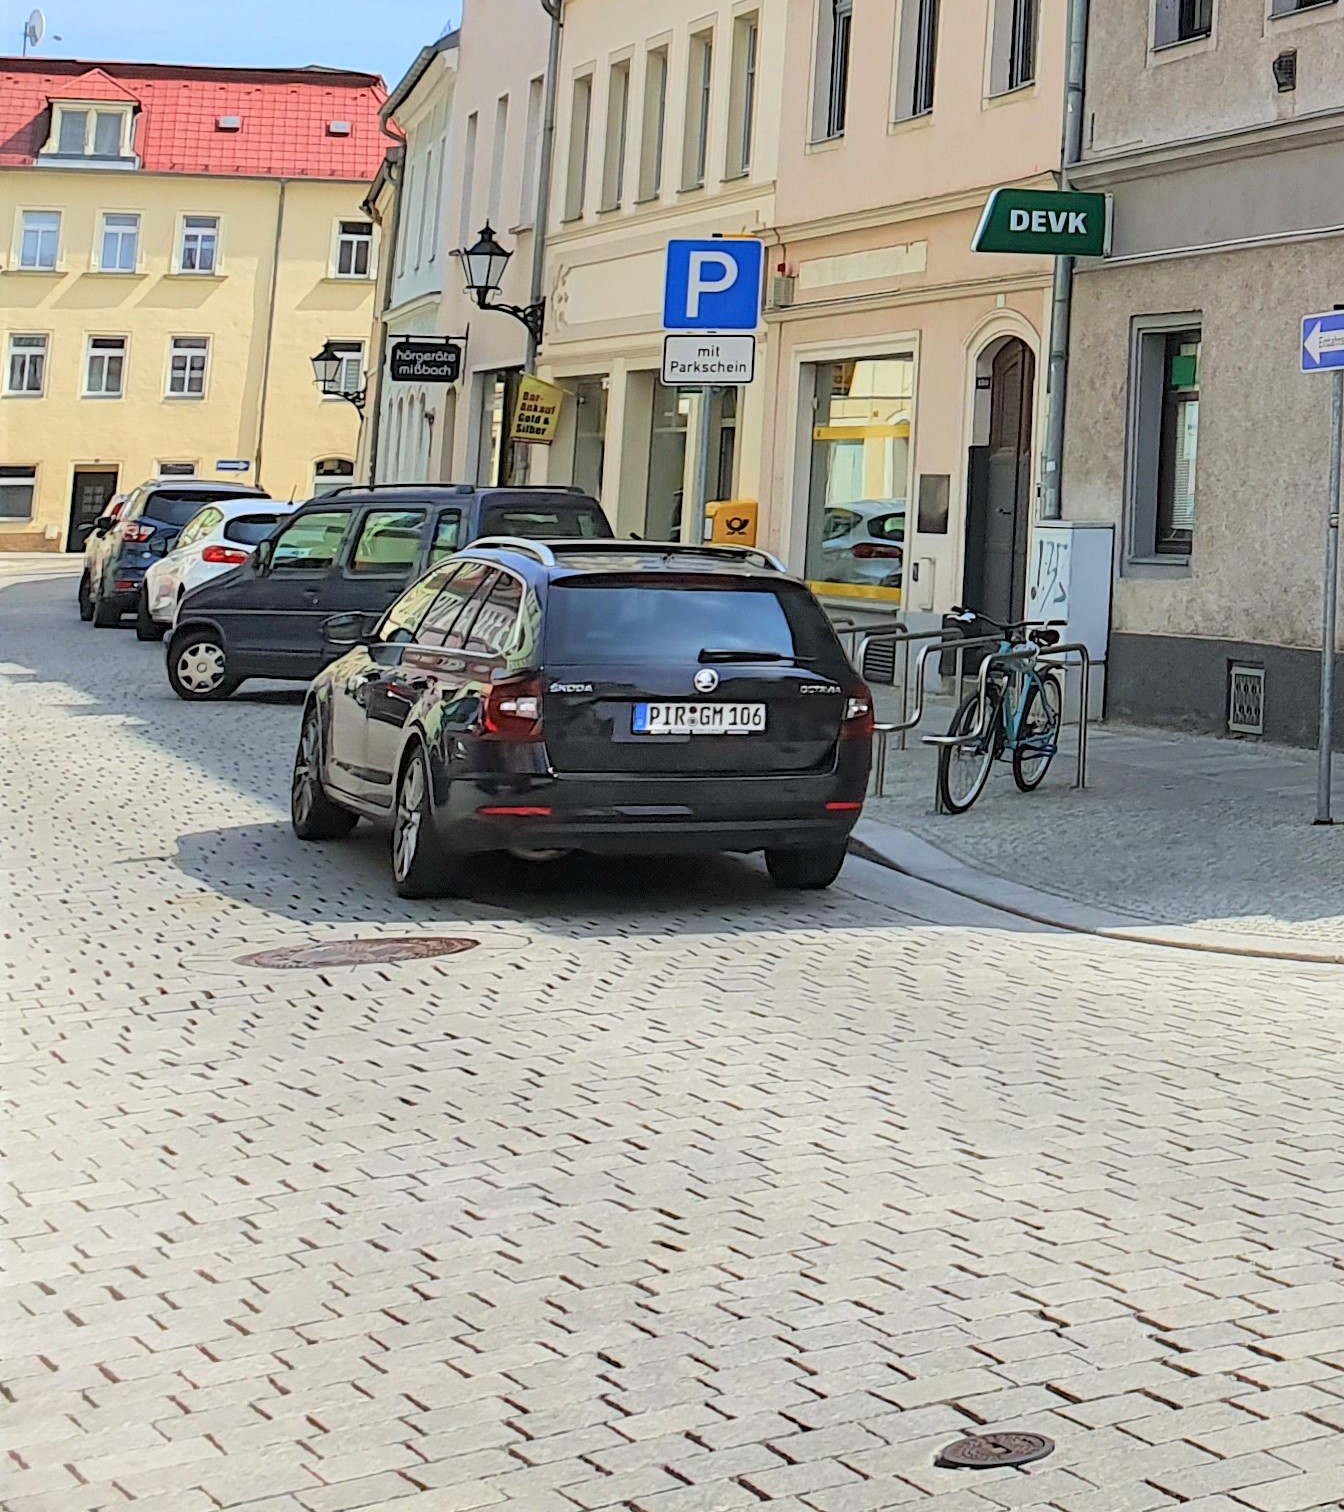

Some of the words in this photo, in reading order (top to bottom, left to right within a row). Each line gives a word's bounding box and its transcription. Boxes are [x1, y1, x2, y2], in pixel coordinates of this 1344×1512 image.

[1009, 209, 1088, 234] DEVK
[686, 251, 739, 318] P
[396, 349, 456, 364] hörgeräte
[698, 345, 720, 357] mit
[670, 361, 747, 373] Parkschein
[518, 413, 541, 424] Gold
[649, 706, 686, 726] PIR
[700, 707, 724, 725] GM
[728, 706, 762, 726] 106
